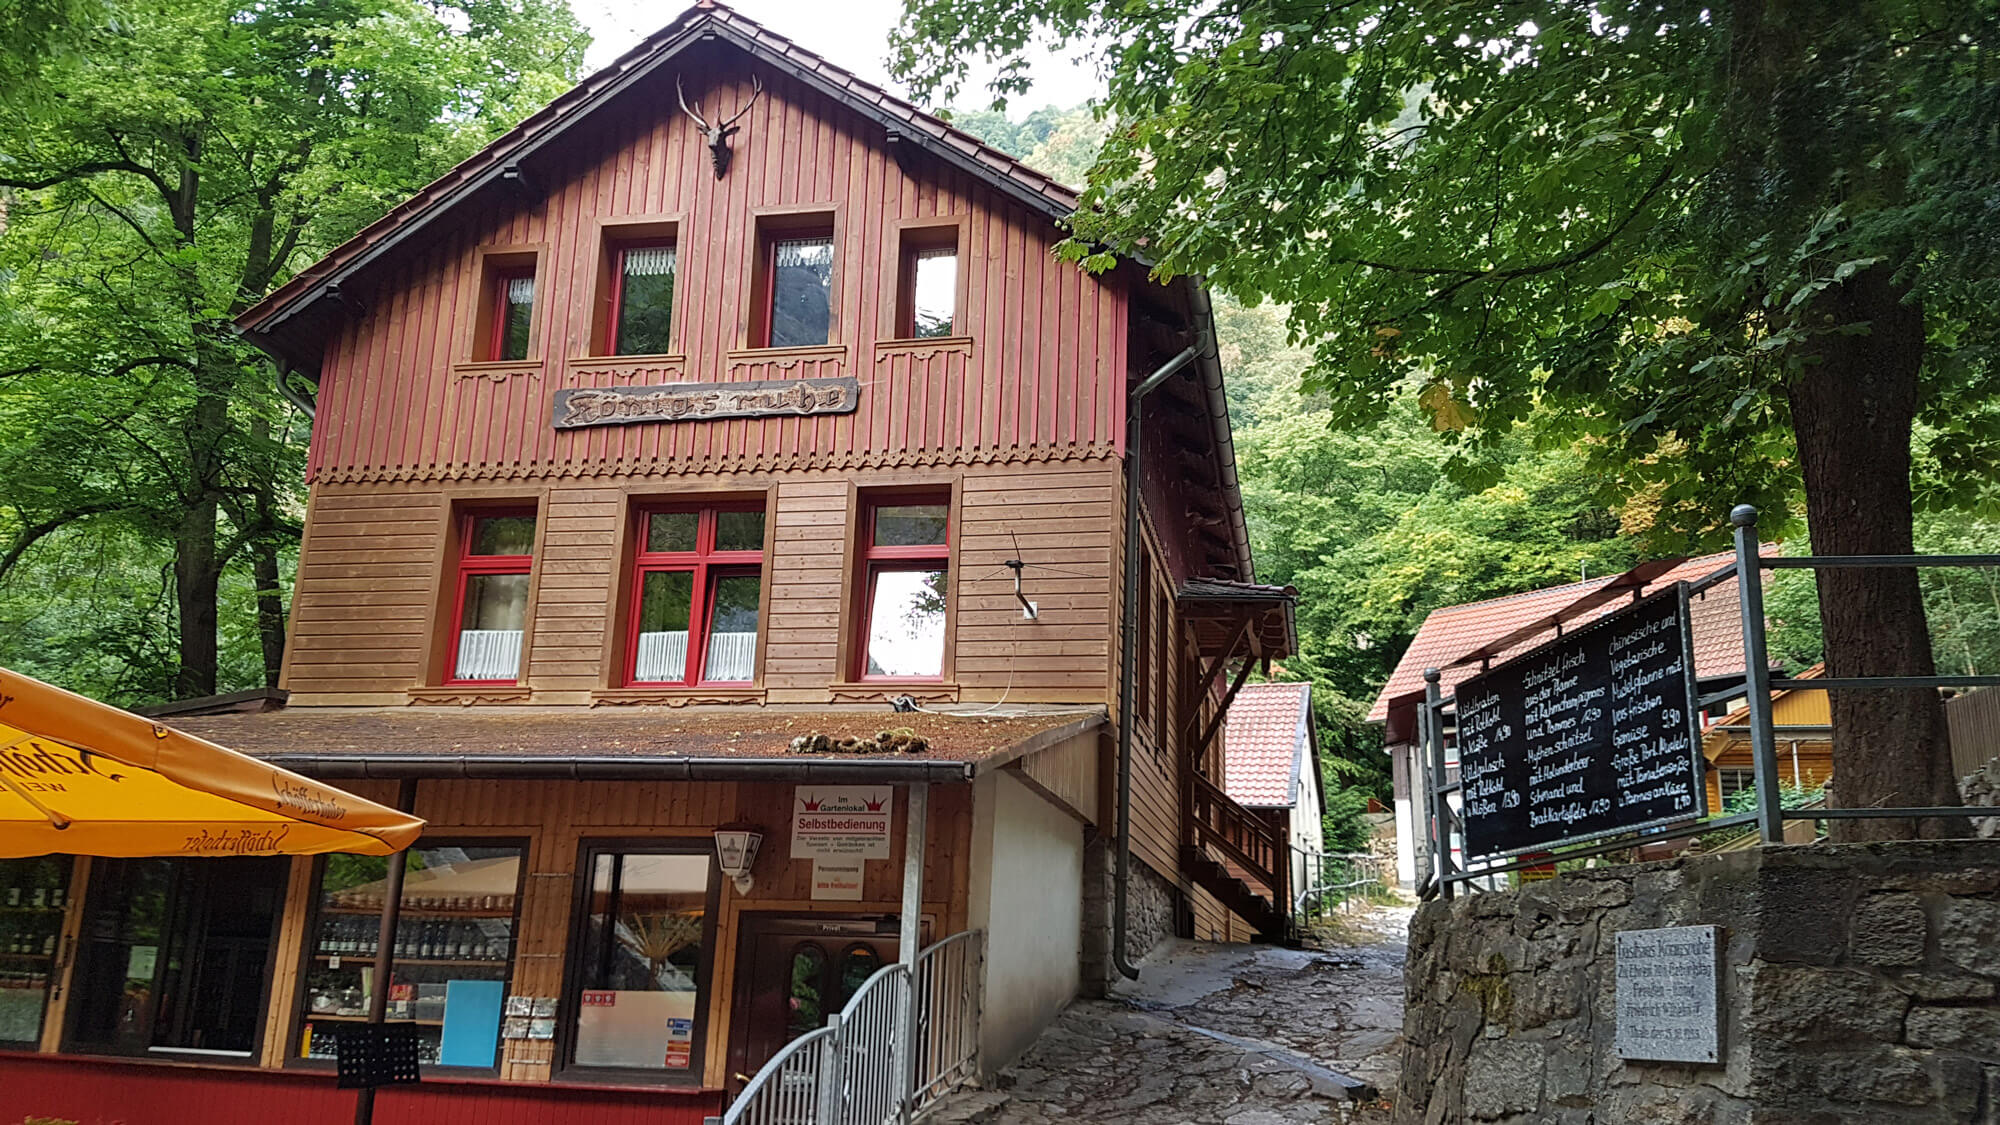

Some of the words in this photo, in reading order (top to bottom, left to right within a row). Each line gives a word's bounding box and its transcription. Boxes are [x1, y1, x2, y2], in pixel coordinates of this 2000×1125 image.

[564, 384, 844, 425] Königsruhe
[1661, 610, 1677, 629] und
[1666, 655, 1682, 676] mit
[1525, 693, 1539, 709] aus
[1539, 687, 1552, 701] der
[1525, 707, 1539, 726] mit
[1462, 718, 1475, 739] mit
[1526, 723, 1545, 740] und
[1545, 717, 1577, 734] Pommes
[1612, 725, 1650, 749] Gemüse
[1529, 766, 1542, 787] mit
[1566, 776, 1585, 795] und
[1617, 770, 1635, 789] mit
[820, 804, 865, 812] Gartenlokal
[798, 818, 886, 832] Selbstbedienung
